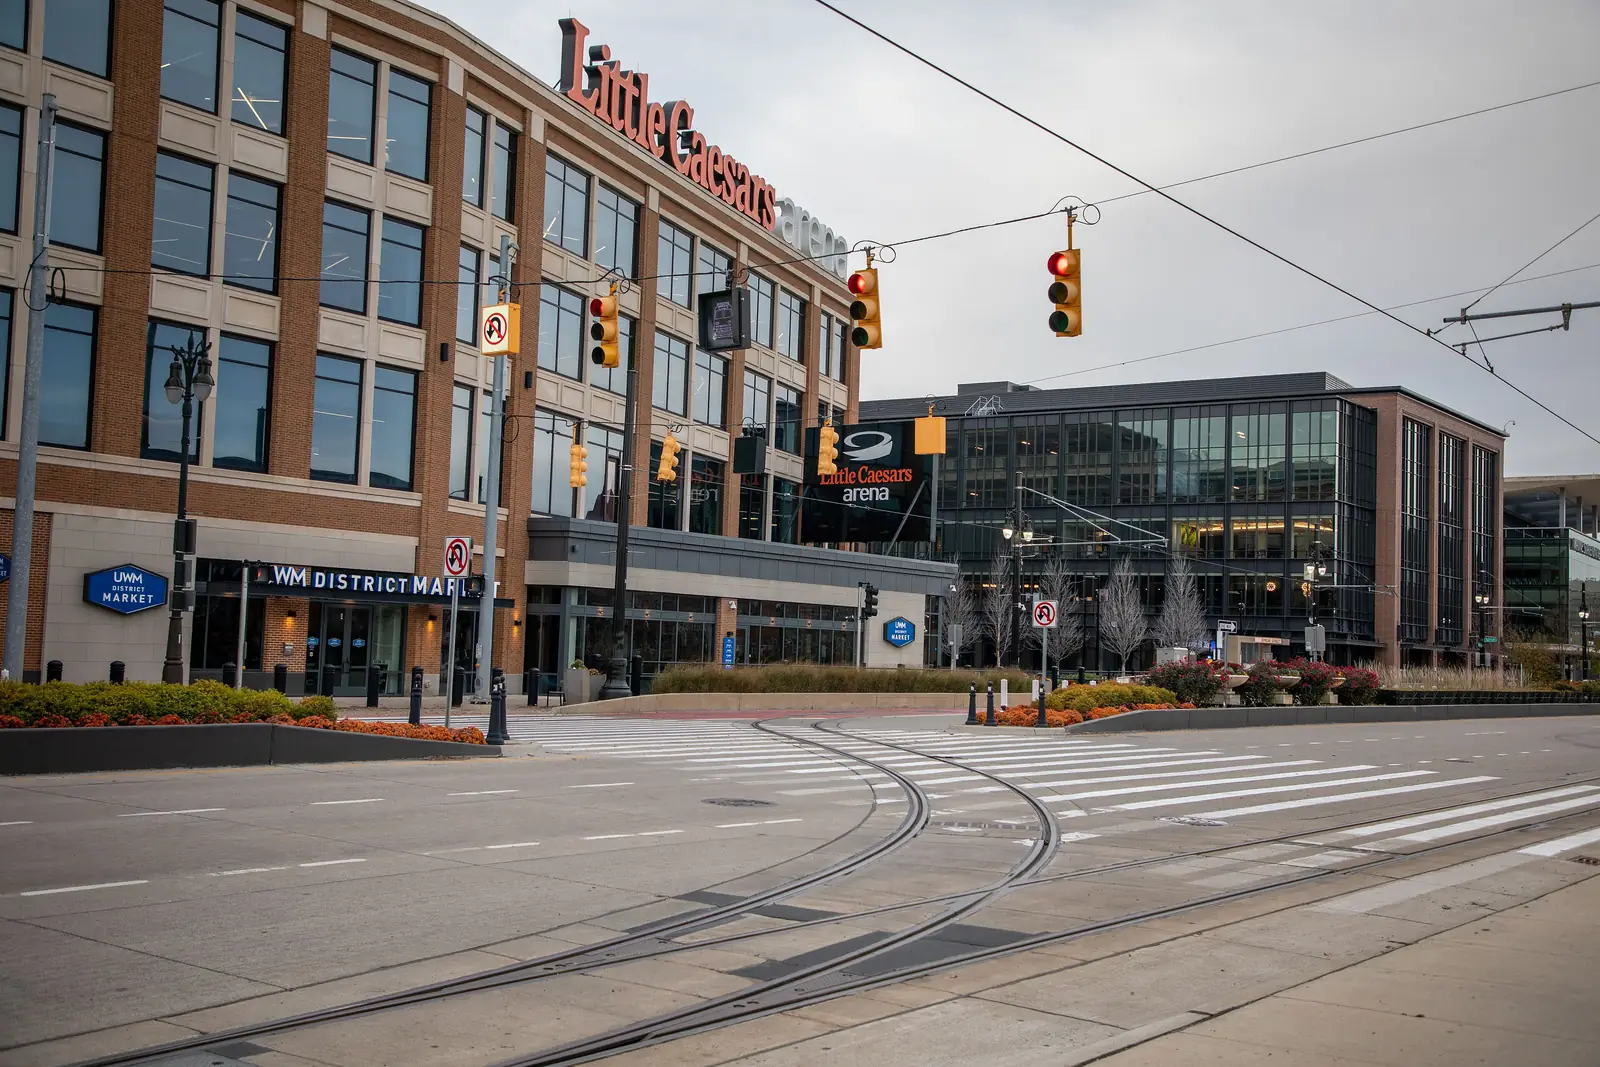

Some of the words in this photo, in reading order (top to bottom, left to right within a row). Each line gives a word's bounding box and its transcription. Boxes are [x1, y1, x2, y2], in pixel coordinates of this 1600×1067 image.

[558, 17, 666, 158] Little
[665, 99, 776, 231] Caesars
[775, 197, 848, 280] arena
[858, 465, 913, 483] Caesars
[843, 486, 890, 502] arena
[113, 571, 143, 584] UWM
[268, 565, 307, 587] WM
[313, 571, 408, 593] DISTRICT
[112, 585, 145, 593] DISTRICT
[102, 592, 154, 604] MARKET
